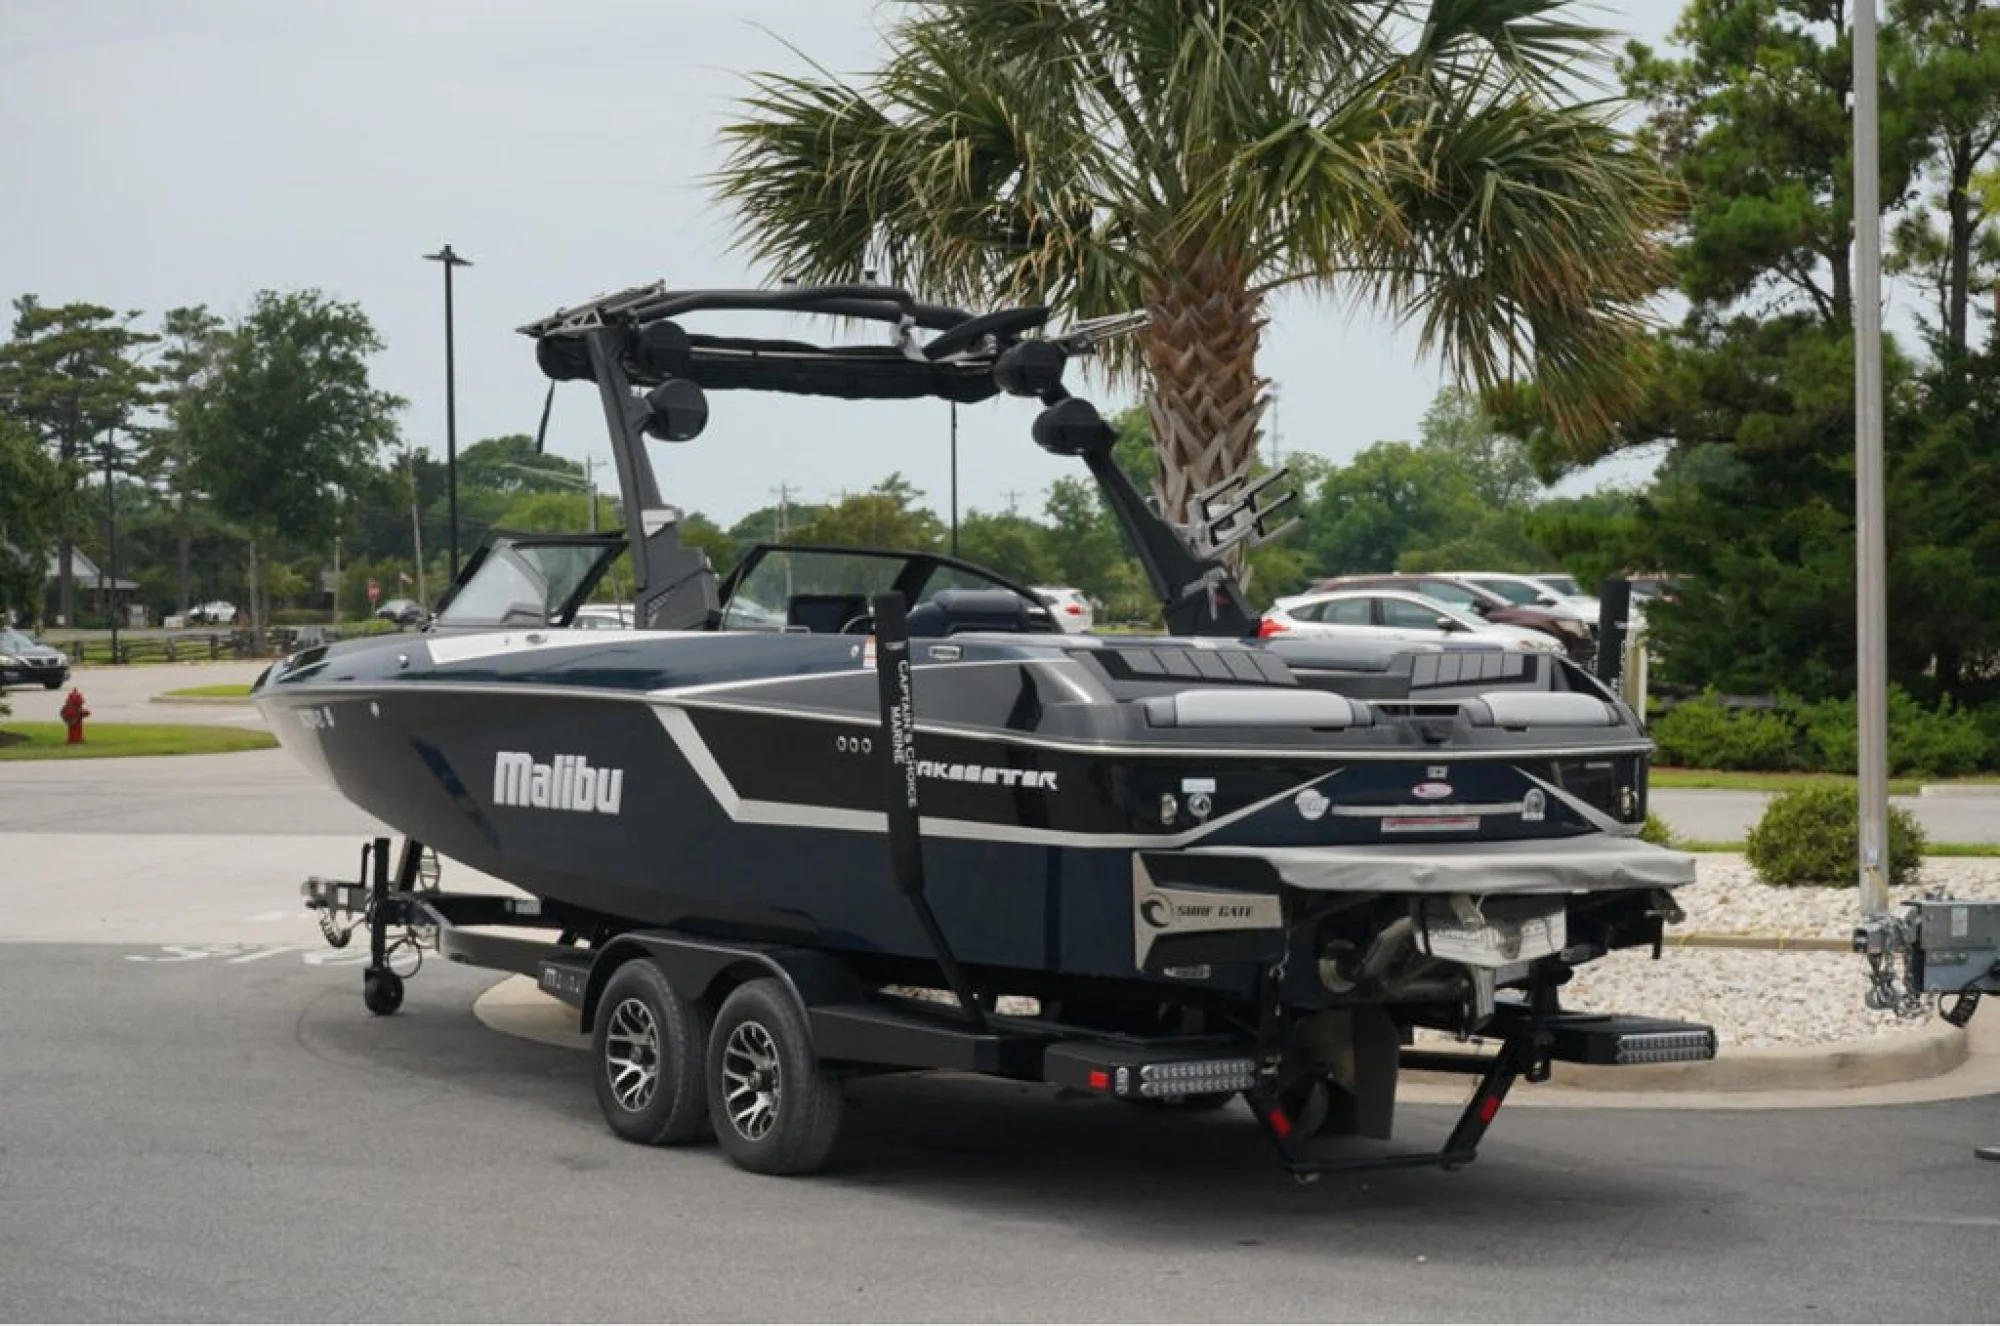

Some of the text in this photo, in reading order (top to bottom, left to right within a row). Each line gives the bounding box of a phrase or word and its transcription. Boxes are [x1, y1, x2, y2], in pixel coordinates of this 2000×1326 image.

[890, 706, 905, 765] MARINE
[494, 751, 623, 814] Malibu
[917, 760, 1058, 791] AKESETTER
[1177, 905, 1252, 917] SURF GATE
